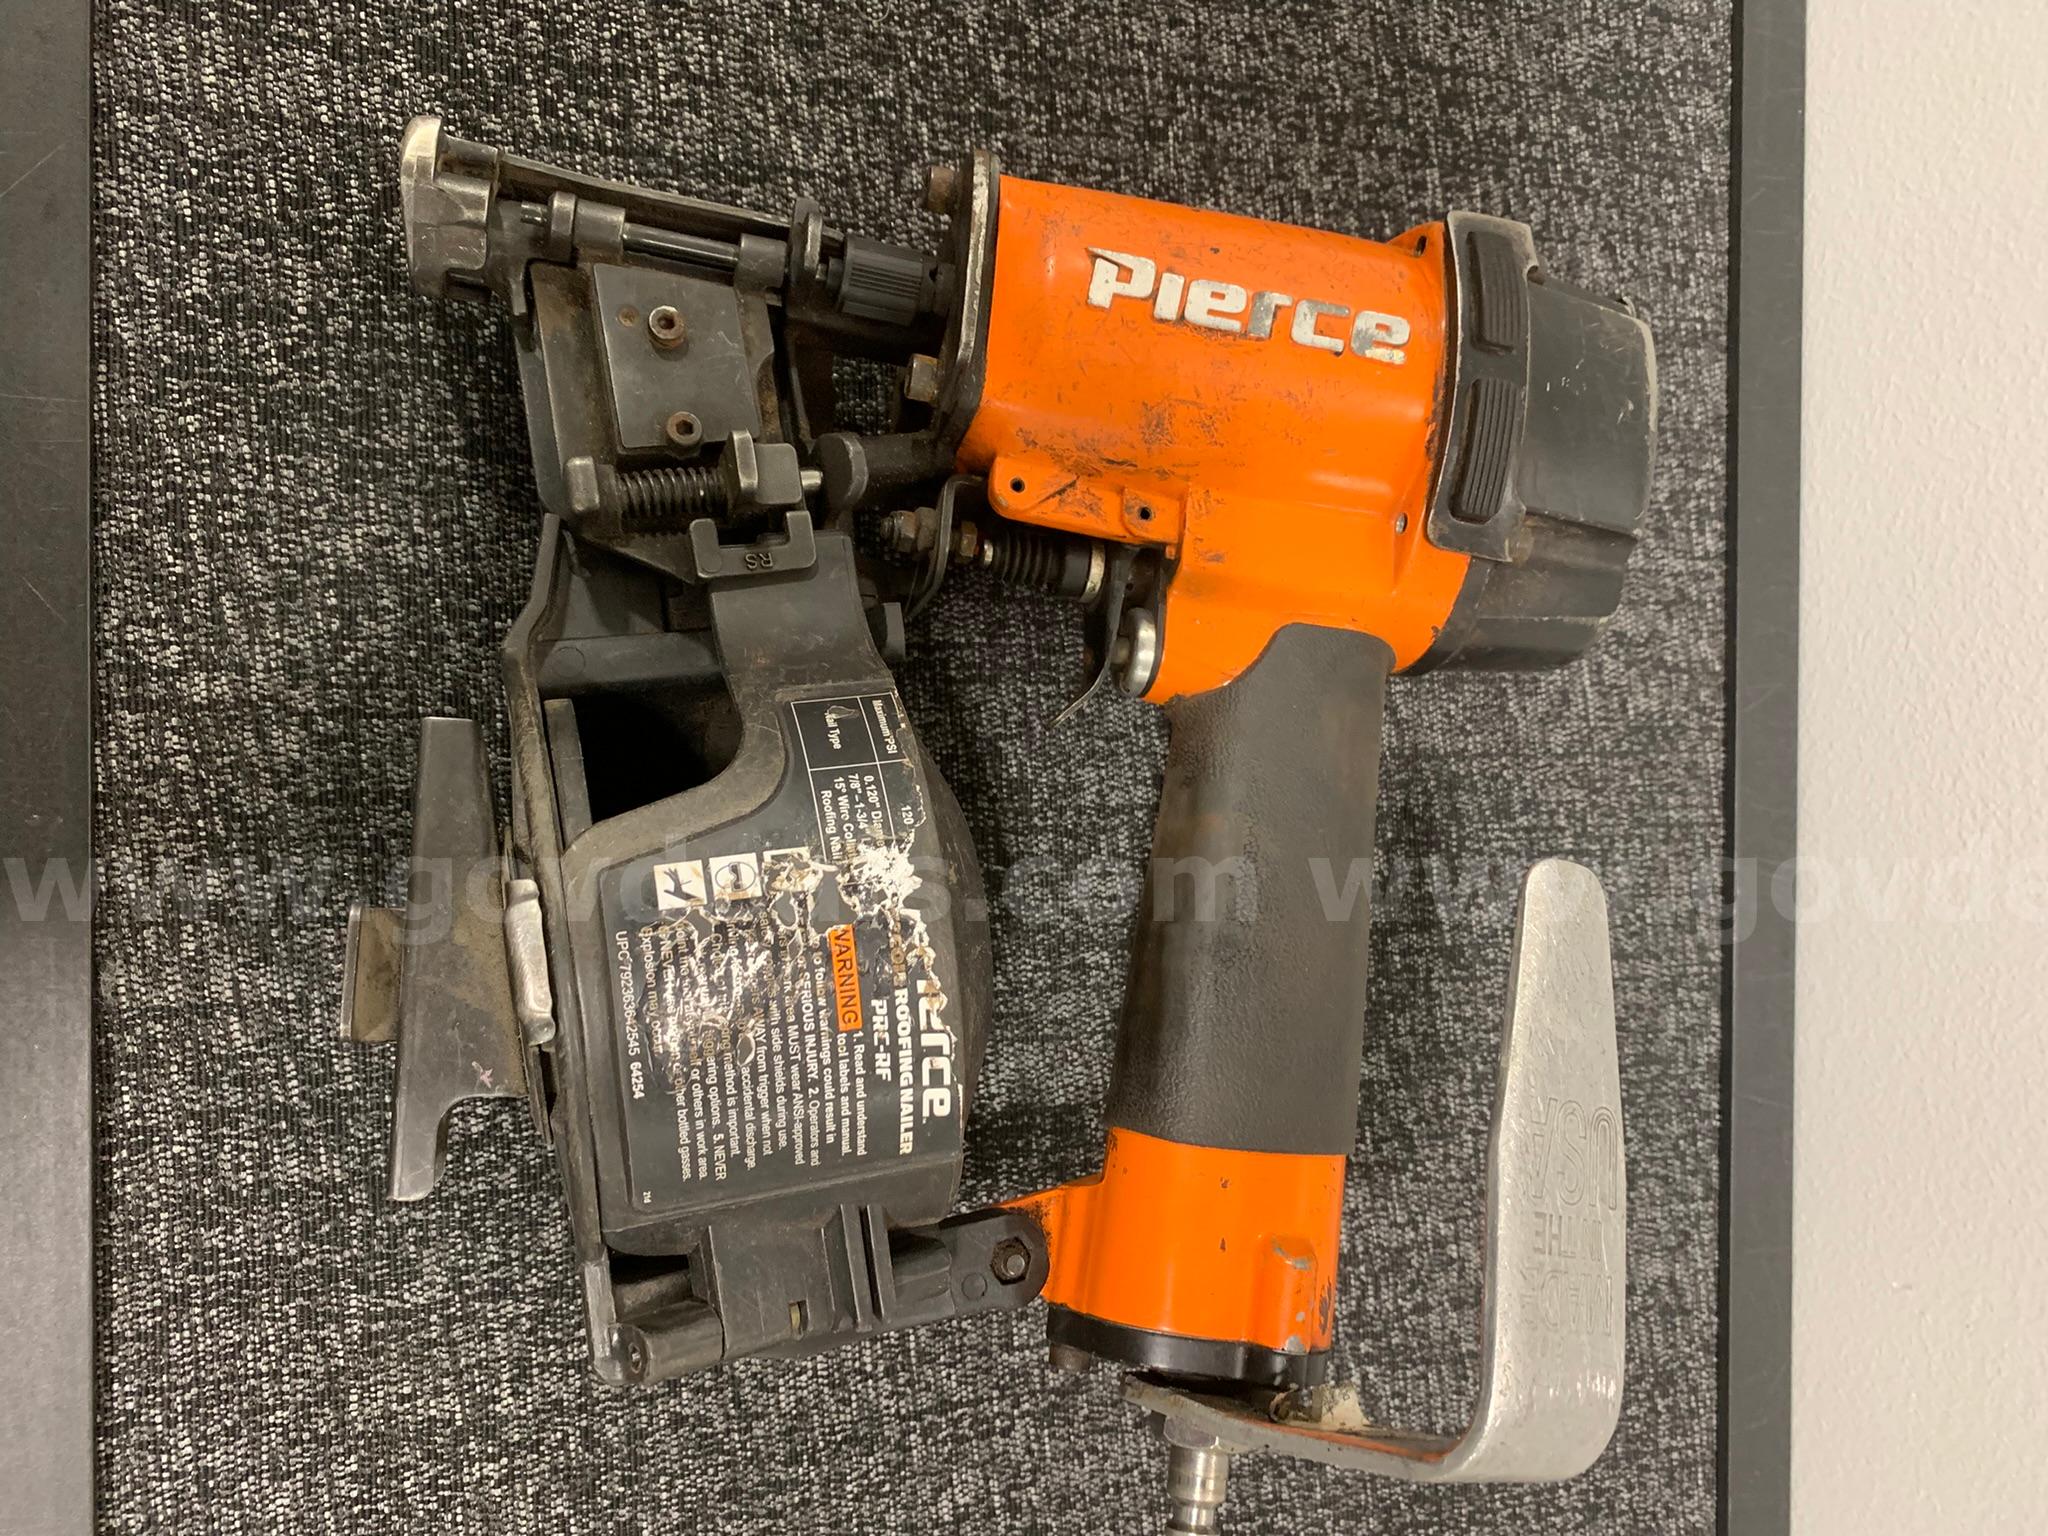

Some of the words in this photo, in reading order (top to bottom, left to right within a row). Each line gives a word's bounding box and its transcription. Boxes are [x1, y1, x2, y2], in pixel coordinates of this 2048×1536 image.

[1087, 247, 1411, 366] Pierce
[745, 552, 773, 569] RS
[828, 728, 842, 749] Type
[872, 699, 891, 737] Maximum
[884, 736, 898, 754] PSI
[837, 795, 850, 820] Wire
[863, 775, 881, 808] 0.120"
[821, 790, 837, 834] Roofing
[901, 805, 914, 825] 120
[616, 931, 631, 961] UPC
[619, 964, 641, 1056] 792363642545
[646, 991, 658, 1017] may
[767, 1000, 783, 1025] with
[785, 996, 797, 1023] area
[799, 972, 815, 1032] SERIOUS
[752, 1008, 767, 1043] AWAY
[770, 1028, 783, 1052] side
[818, 1008, 833, 1065] warnings
[853, 1031, 864, 1042] 1.
[894, 988, 914, 1087] ROOFING
[756, 1046, 768, 1072] from
[787, 1025, 801, 1062] MUST
[804, 1034, 819, 1082] INJURY.
[837, 1032, 849, 1057] tool
[854, 1044, 866, 1075] Read
[916, 979, 951, 1117] ierce
[630, 1062, 645, 1099] 64254
[690, 1068, 701, 1080] or
[723, 1053, 738, 1095] method
[773, 1055, 786, 1094] shields
[790, 1064, 800, 1091] wear
[823, 1068, 835, 1100] could
[839, 1059, 851, 1093] labels
[856, 1077, 867, 1098] and
[675, 1078, 687, 1106] other
[692, 1083, 704, 1118] others
[707, 1086, 721, 1128] options.
[727, 1096, 738, 1107] is
[741, 1067, 756, 1121] accidental
[756, 1074, 770, 1109] trigger
[808, 1087, 819, 1098] 2.
[840, 1096, 852, 1116] and
[677, 1109, 691, 1144] bottled
[695, 1120, 706, 1130] in
[761, 1111, 771, 1138] when
[775, 1096, 788, 1128] during
[807, 1100, 820, 1148] Operators
[825, 1102, 836, 1132] result
[856, 1100, 867, 1156] understand
[899, 1087, 914, 1155] NAILER
[696, 1131, 708, 1155] work
[713, 1134, 724, 1144] 5.
[727, 1108, 741, 1158] important.
[777, 1130, 787, 1150] use.
[791, 1093, 806, 1166] ANSI-approved
[826, 1133, 836, 1144] in
[841, 1118, 852, 1156] manual.
[744, 1123, 757, 1171] discharge.
[762, 1140, 773, 1156] not
[811, 1149, 821, 1166] and
[1523, 1094, 1620, 1211] USA
[678, 1146, 692, 1182] gasses.
[698, 1157, 708, 1180] area.
[714, 1146, 727, 1181] NEVER
[1533, 1210, 1577, 1259] THE
